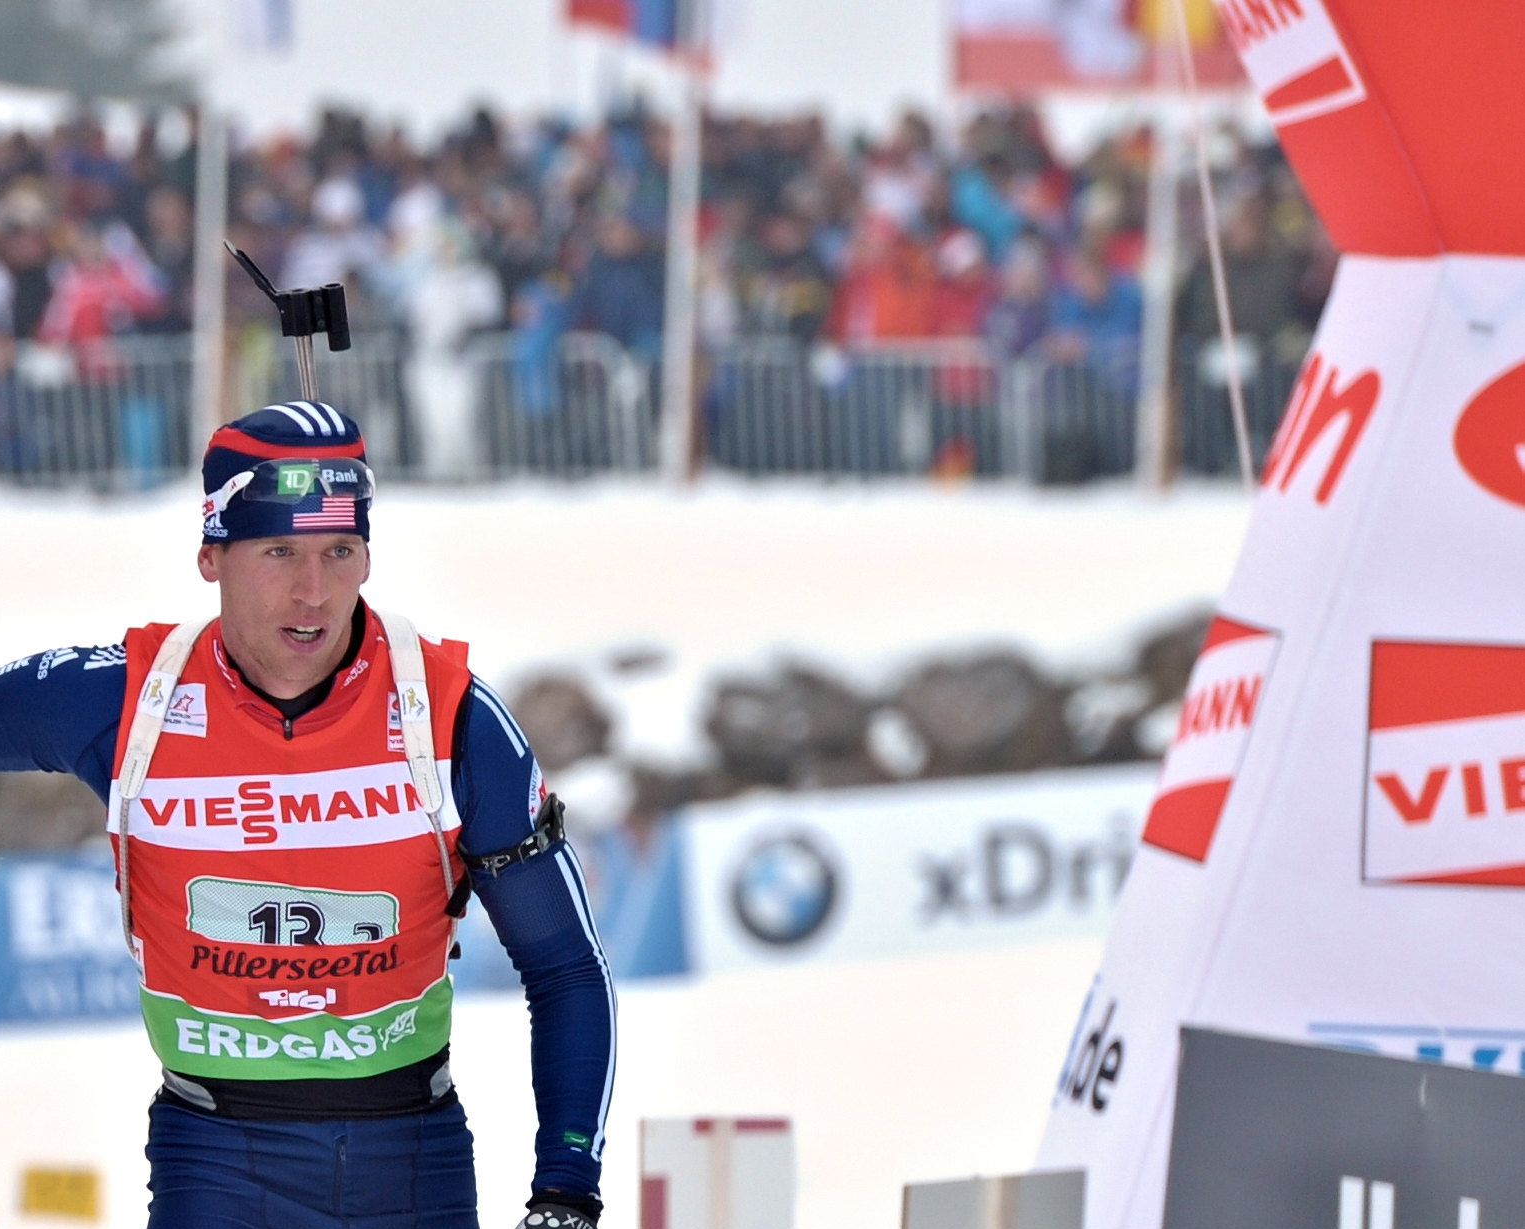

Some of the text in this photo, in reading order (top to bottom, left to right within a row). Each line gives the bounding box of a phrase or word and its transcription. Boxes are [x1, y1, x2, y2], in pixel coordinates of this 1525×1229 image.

[321, 469, 359, 484] Bank
[248, 901, 326, 947] 13
[258, 987, 337, 1011] Tirol
[175, 1016, 378, 1061] ERDGAS
